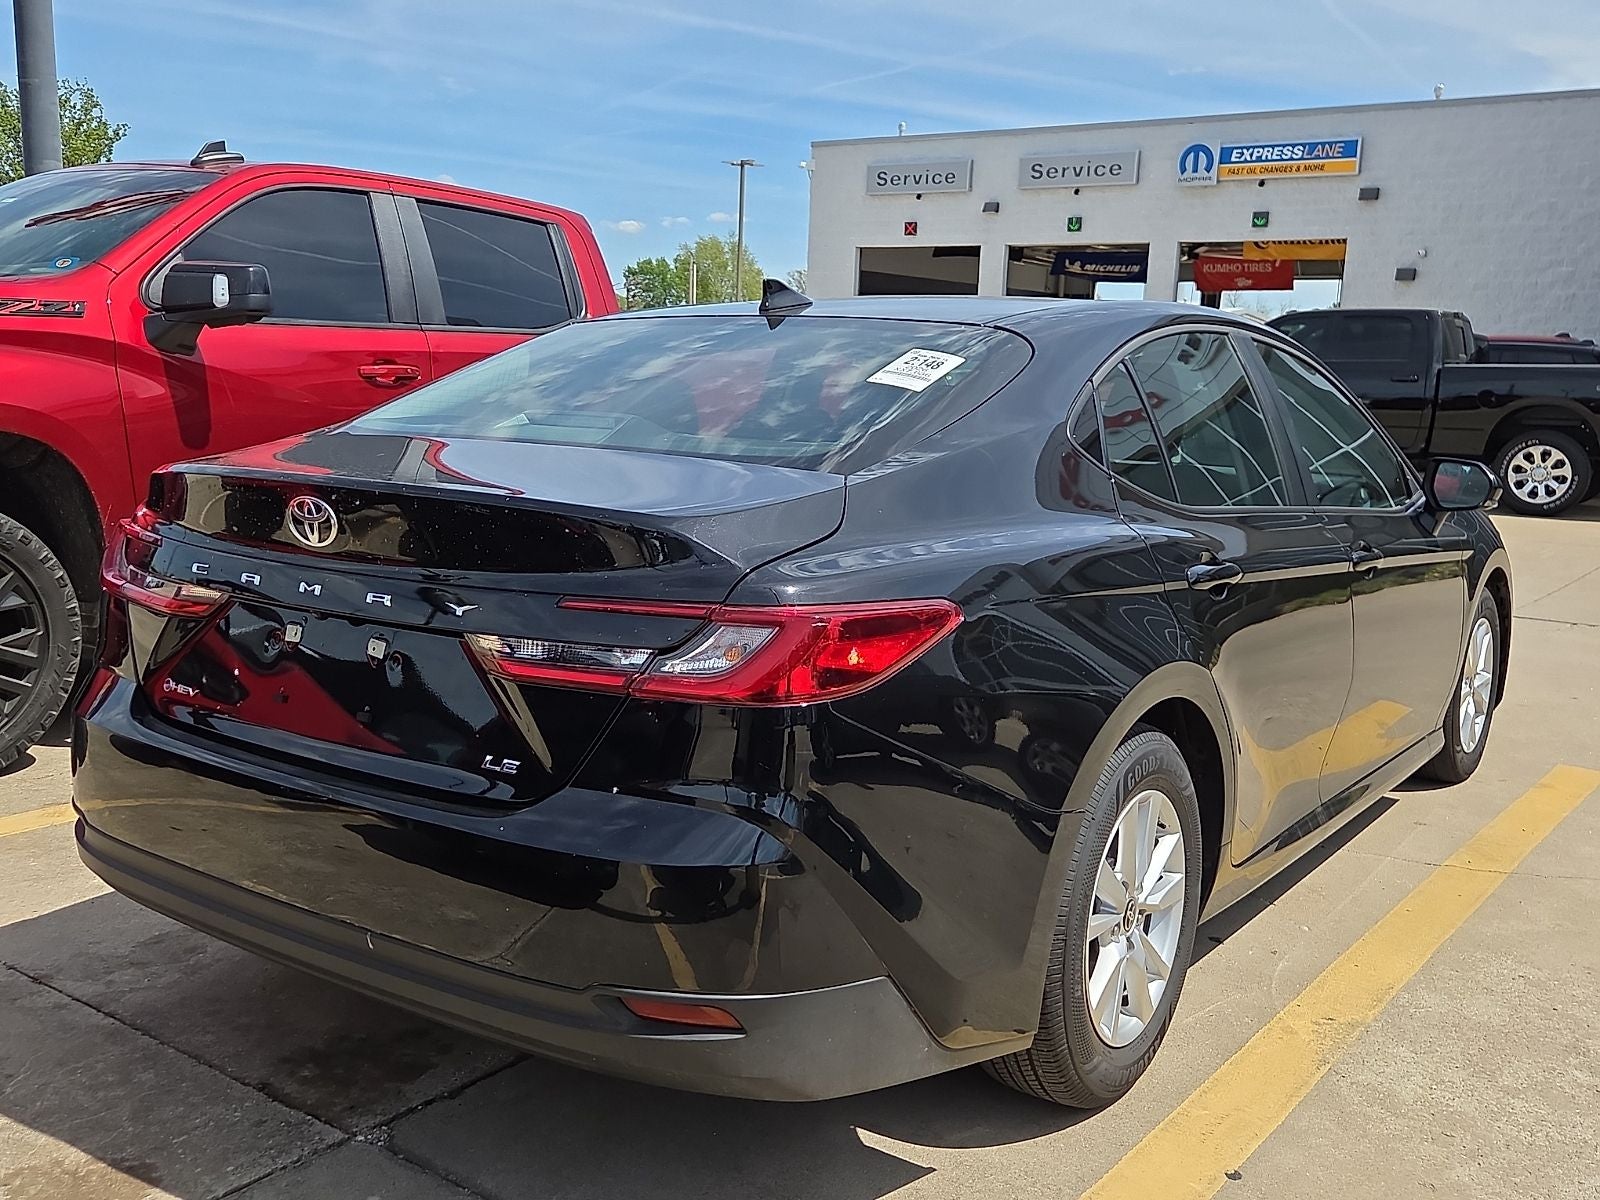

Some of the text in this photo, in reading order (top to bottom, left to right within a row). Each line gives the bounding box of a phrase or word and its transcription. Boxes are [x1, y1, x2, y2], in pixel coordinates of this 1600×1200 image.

[1230, 143, 1345, 162] EXPRESSLANE
[1030, 160, 1123, 180] Service
[1227, 163, 1326, 175] FAST OIL CHANGES & MORE
[876, 169, 956, 187] Service
[1177, 175, 1213, 184] MOPAR
[1083, 263, 1141, 273] MICHELIN
[1203, 262, 1273, 273] KUMHO TIRES
[903, 356, 945, 370] 2:148
[191, 562, 479, 617] CAMRY
[481, 754, 522, 775] LE
